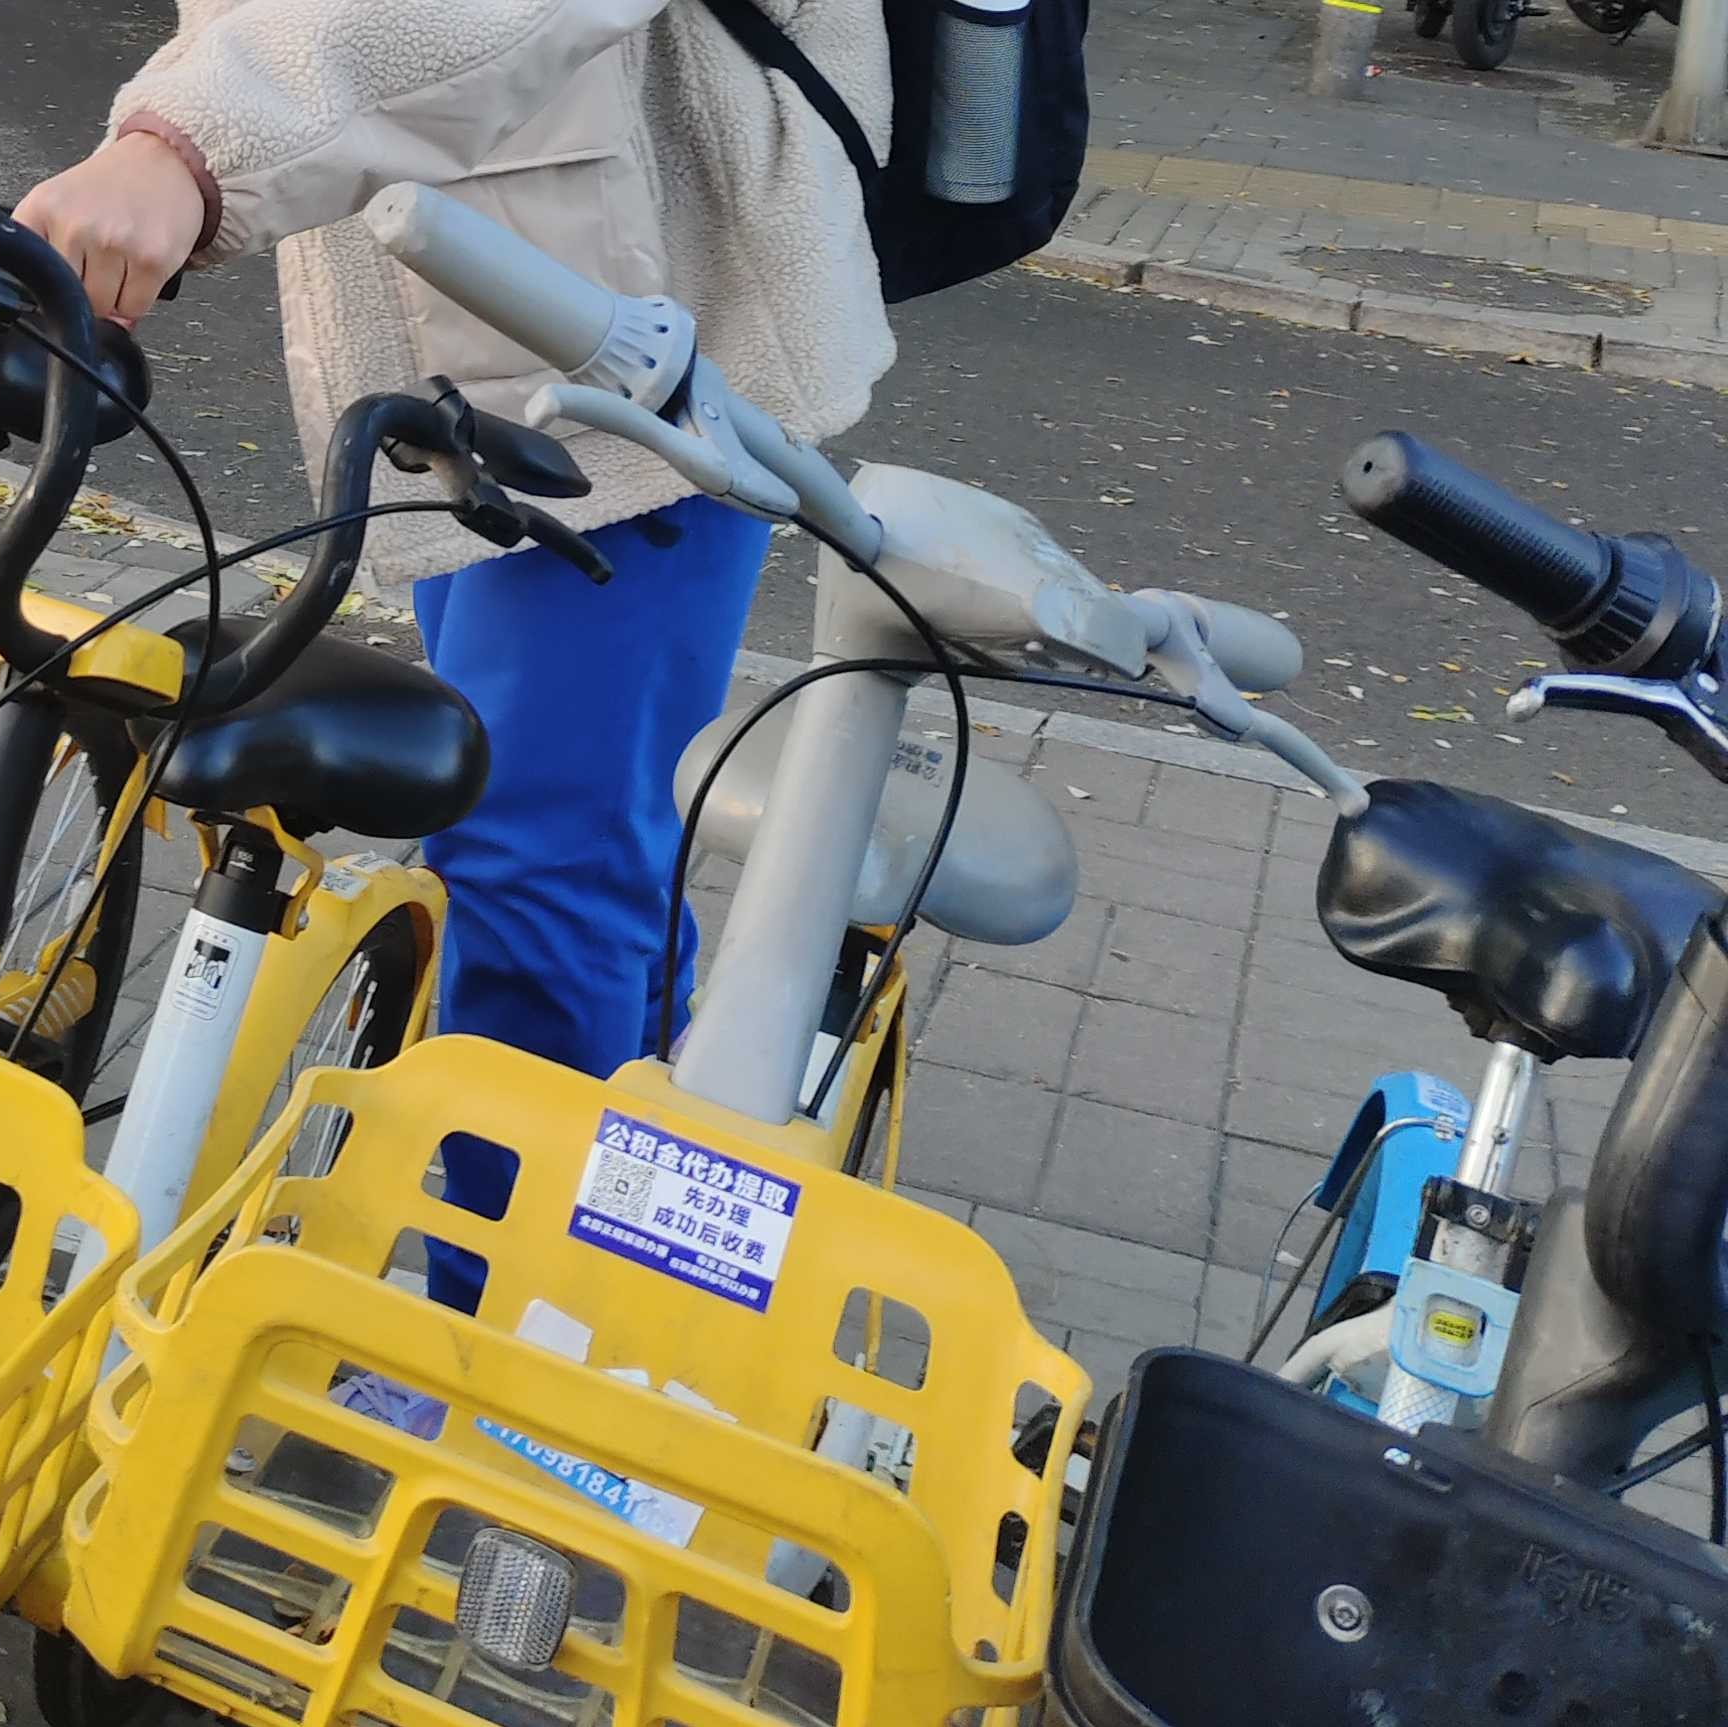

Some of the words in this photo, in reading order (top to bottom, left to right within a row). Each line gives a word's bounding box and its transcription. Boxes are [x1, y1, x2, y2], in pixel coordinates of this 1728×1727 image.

[603, 1122, 791, 1212] 公积金代办提取
[652, 1206, 767, 1264] 成功后收费
[683, 1185, 752, 1228] 先办理
